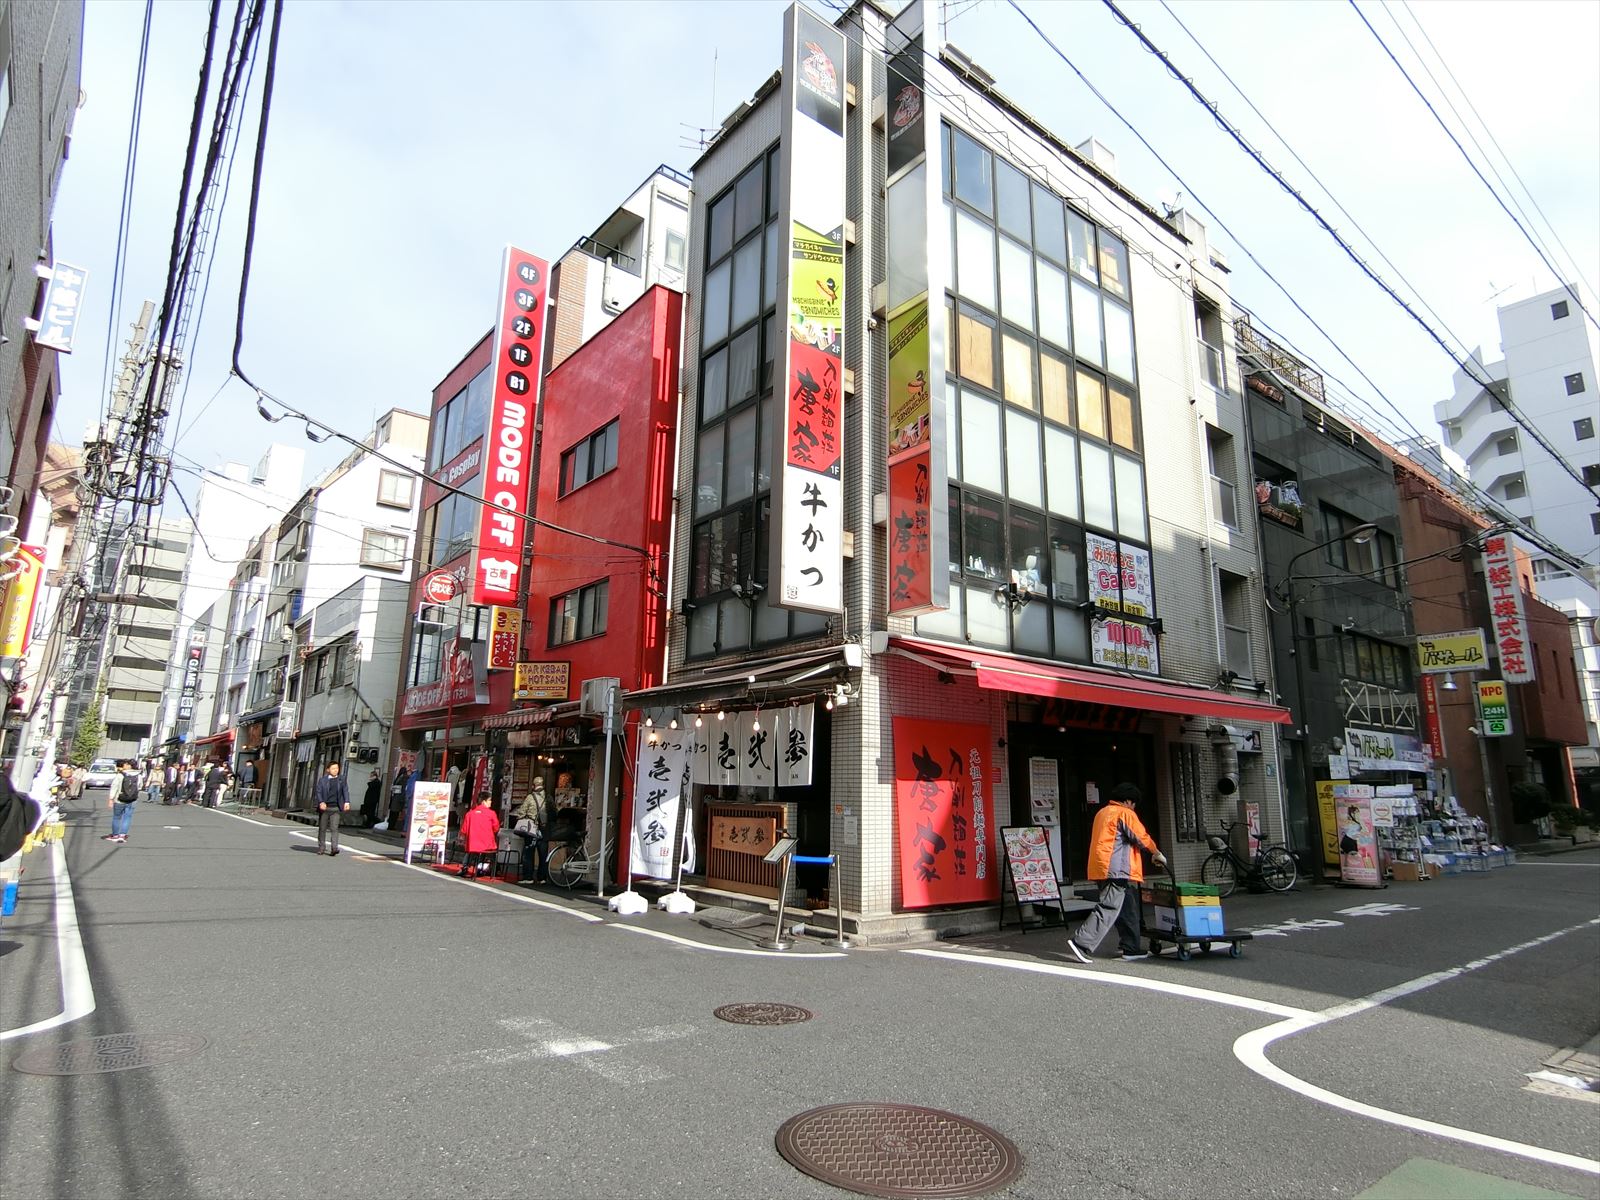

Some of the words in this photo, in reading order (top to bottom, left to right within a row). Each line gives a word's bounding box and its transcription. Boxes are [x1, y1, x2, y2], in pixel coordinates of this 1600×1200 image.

[831, 231, 842, 242] 3F
[520, 266, 536, 280] 4F
[518, 292, 534, 307] 3F
[516, 320, 531, 335] 2F
[514, 348, 527, 361] 1F
[831, 344, 841, 354] 2F
[509, 375, 525, 391] B1
[497, 400, 526, 486] MODE
[829, 464, 840, 475] 1F
[491, 493, 516, 547] OFF
[799, 482, 828, 588] 牛かつ
[489, 566, 508, 580] 古着
[1097, 569, 1137, 591] Cafe
[431, 582, 454, 596] 消火栓
[1485, 536, 1528, 676] 第一紙工株式会社
[494, 634, 502, 655] サンド
[501, 632, 509, 652] ホット
[1423, 647, 1483, 666] バザール
[186, 658, 199, 689] GAME
[518, 664, 540, 675] STAR
[540, 664, 568, 675] KEBAB
[1481, 686, 1503, 697] NPC
[1484, 706, 1505, 716] 24H
[648, 741, 682, 751] 牛かつ
[969, 748, 987, 880] 元祖刀削麺専門店
